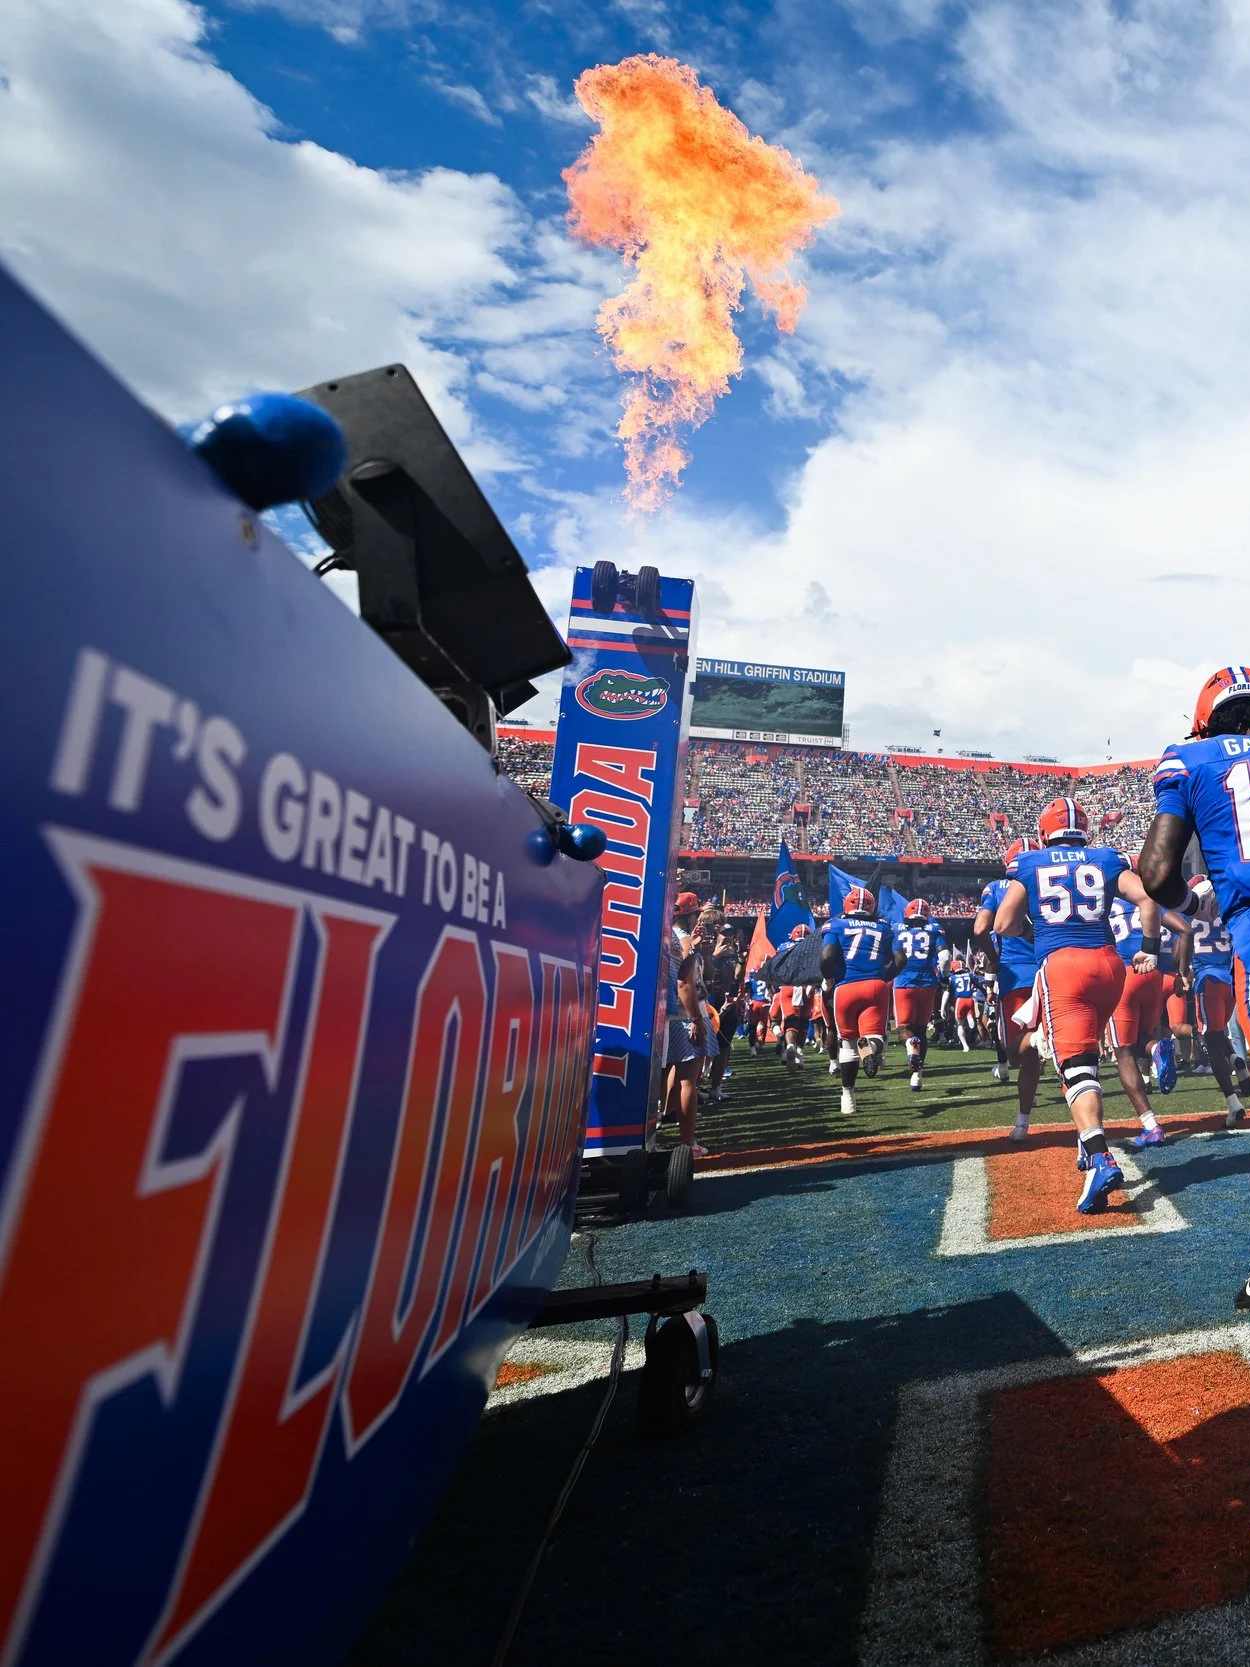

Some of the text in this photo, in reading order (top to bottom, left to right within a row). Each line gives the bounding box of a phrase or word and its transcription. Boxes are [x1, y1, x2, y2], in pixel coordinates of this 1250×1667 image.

[714, 663, 741, 675] HILL
[744, 666, 790, 680] GRIFFIN
[793, 670, 842, 684] STADIUM
[49, 646, 506, 930] IT'S GREAT TO BE A
[1051, 851, 1086, 863] CLEM
[1036, 864, 1105, 925] 59
[844, 928, 883, 961] 77
[898, 932, 930, 959] 33
[955, 976, 970, 992] 37
